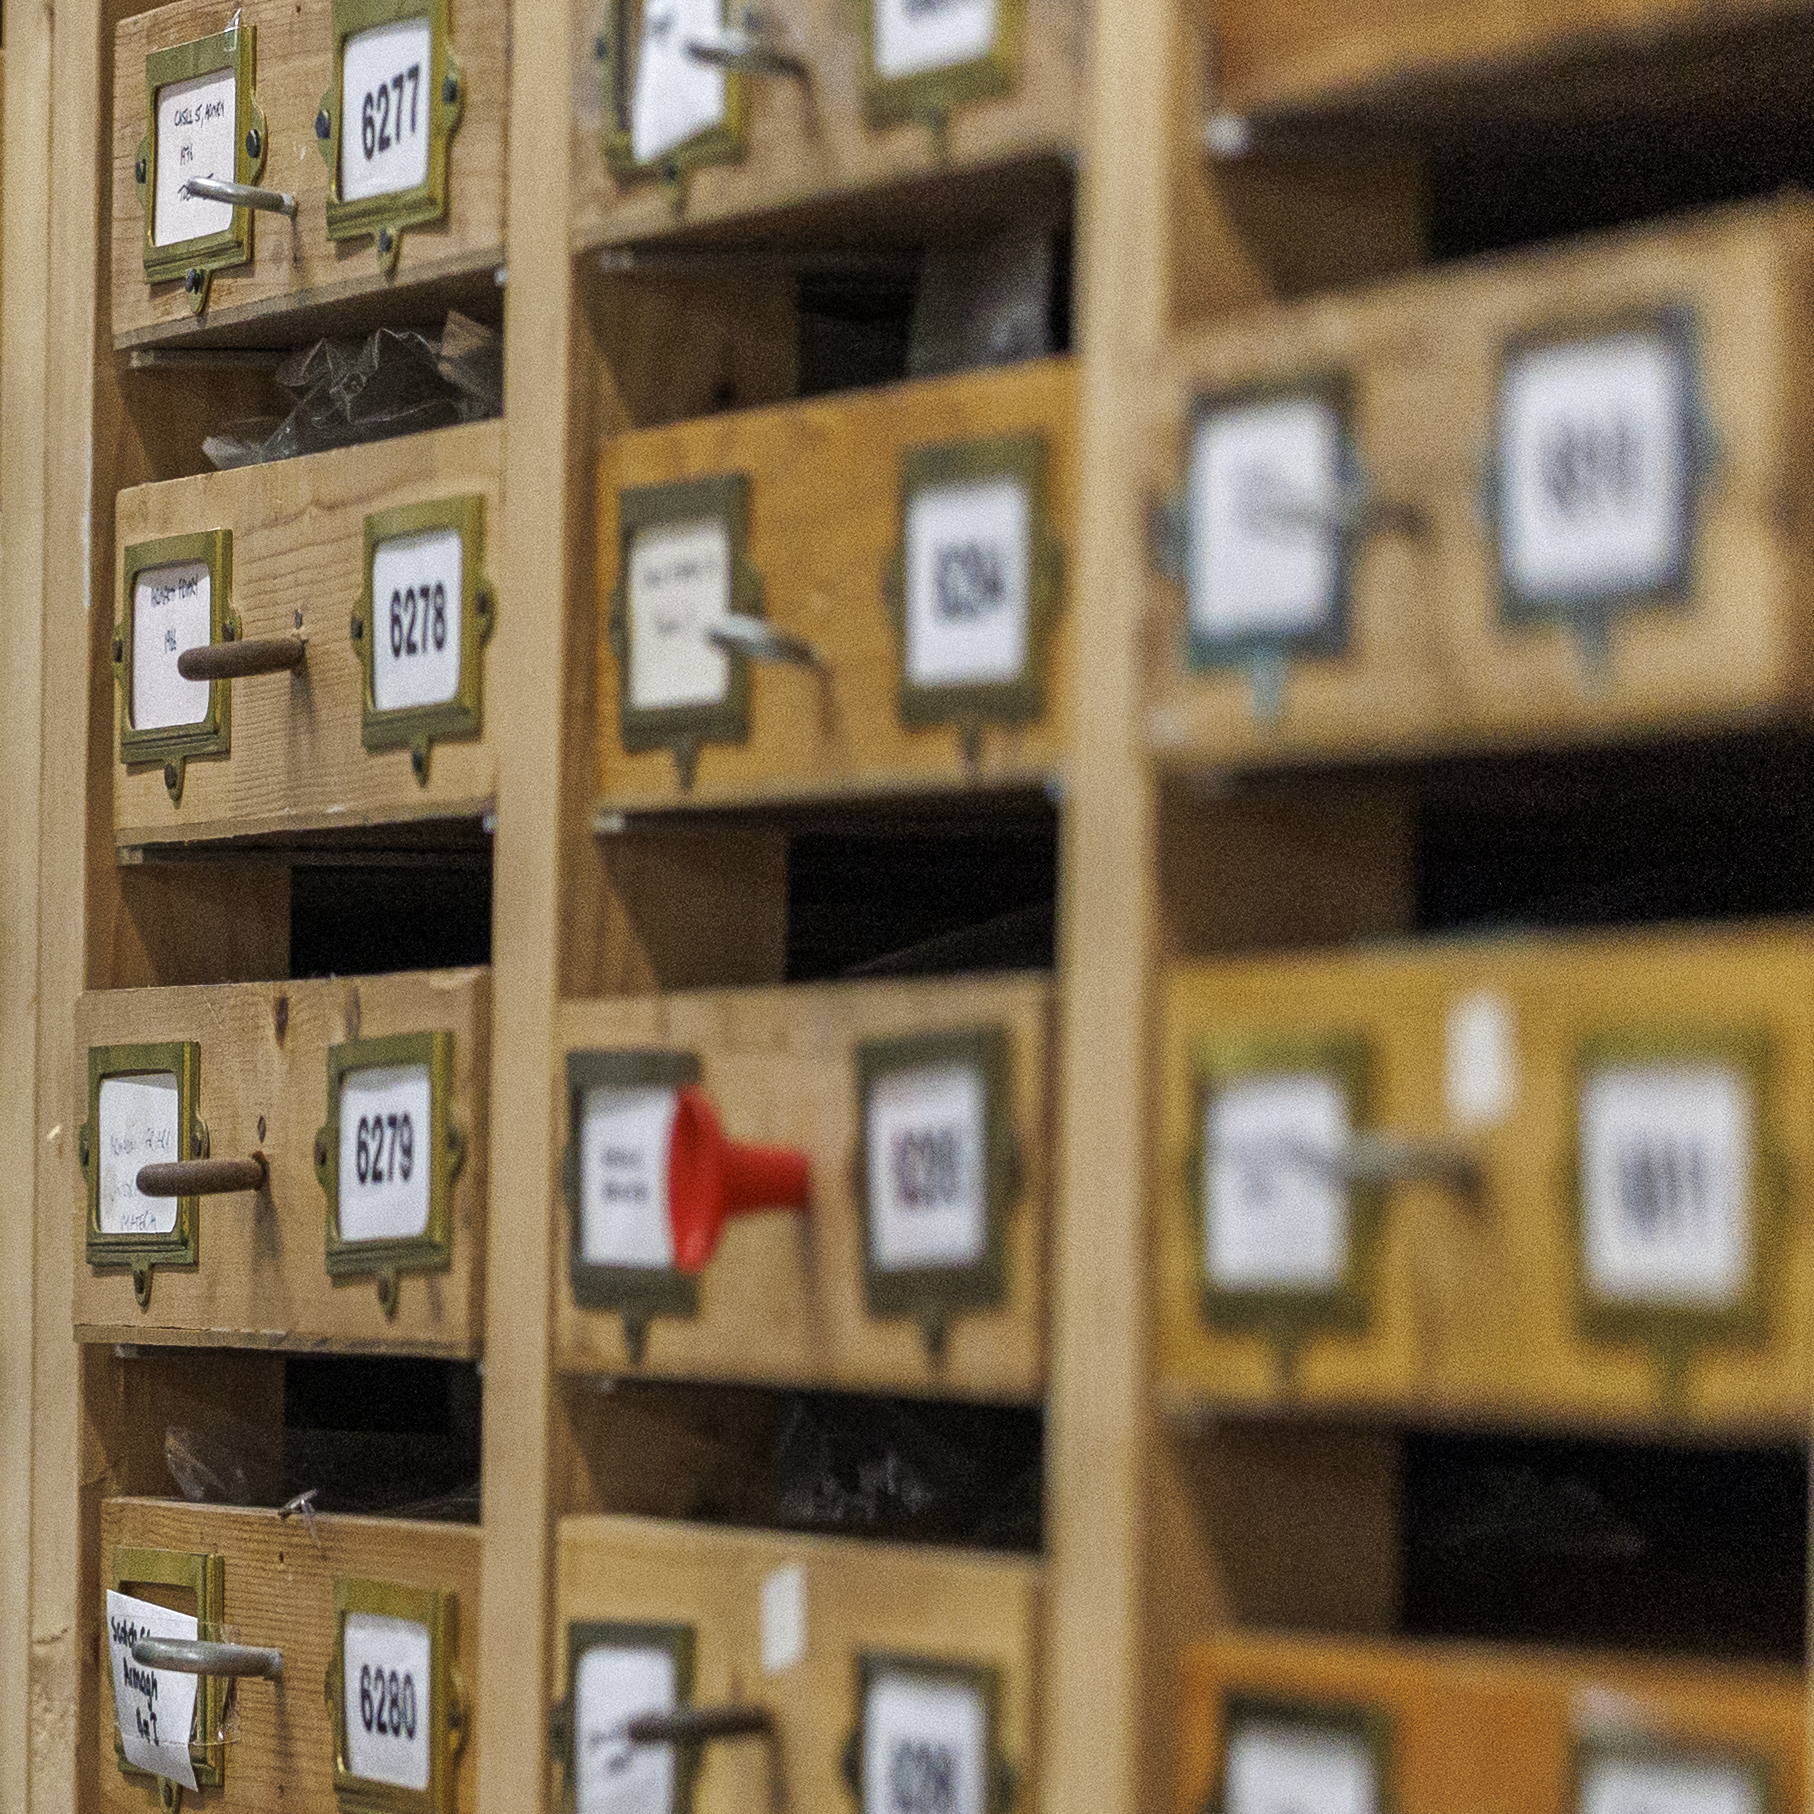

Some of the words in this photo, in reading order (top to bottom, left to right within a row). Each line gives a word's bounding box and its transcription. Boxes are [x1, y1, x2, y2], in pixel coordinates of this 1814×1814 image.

[361, 63, 421, 161] 6277
[389, 582, 447, 659] 6278
[356, 1112, 414, 1186] 6279
[359, 1664, 417, 1741] 6280
